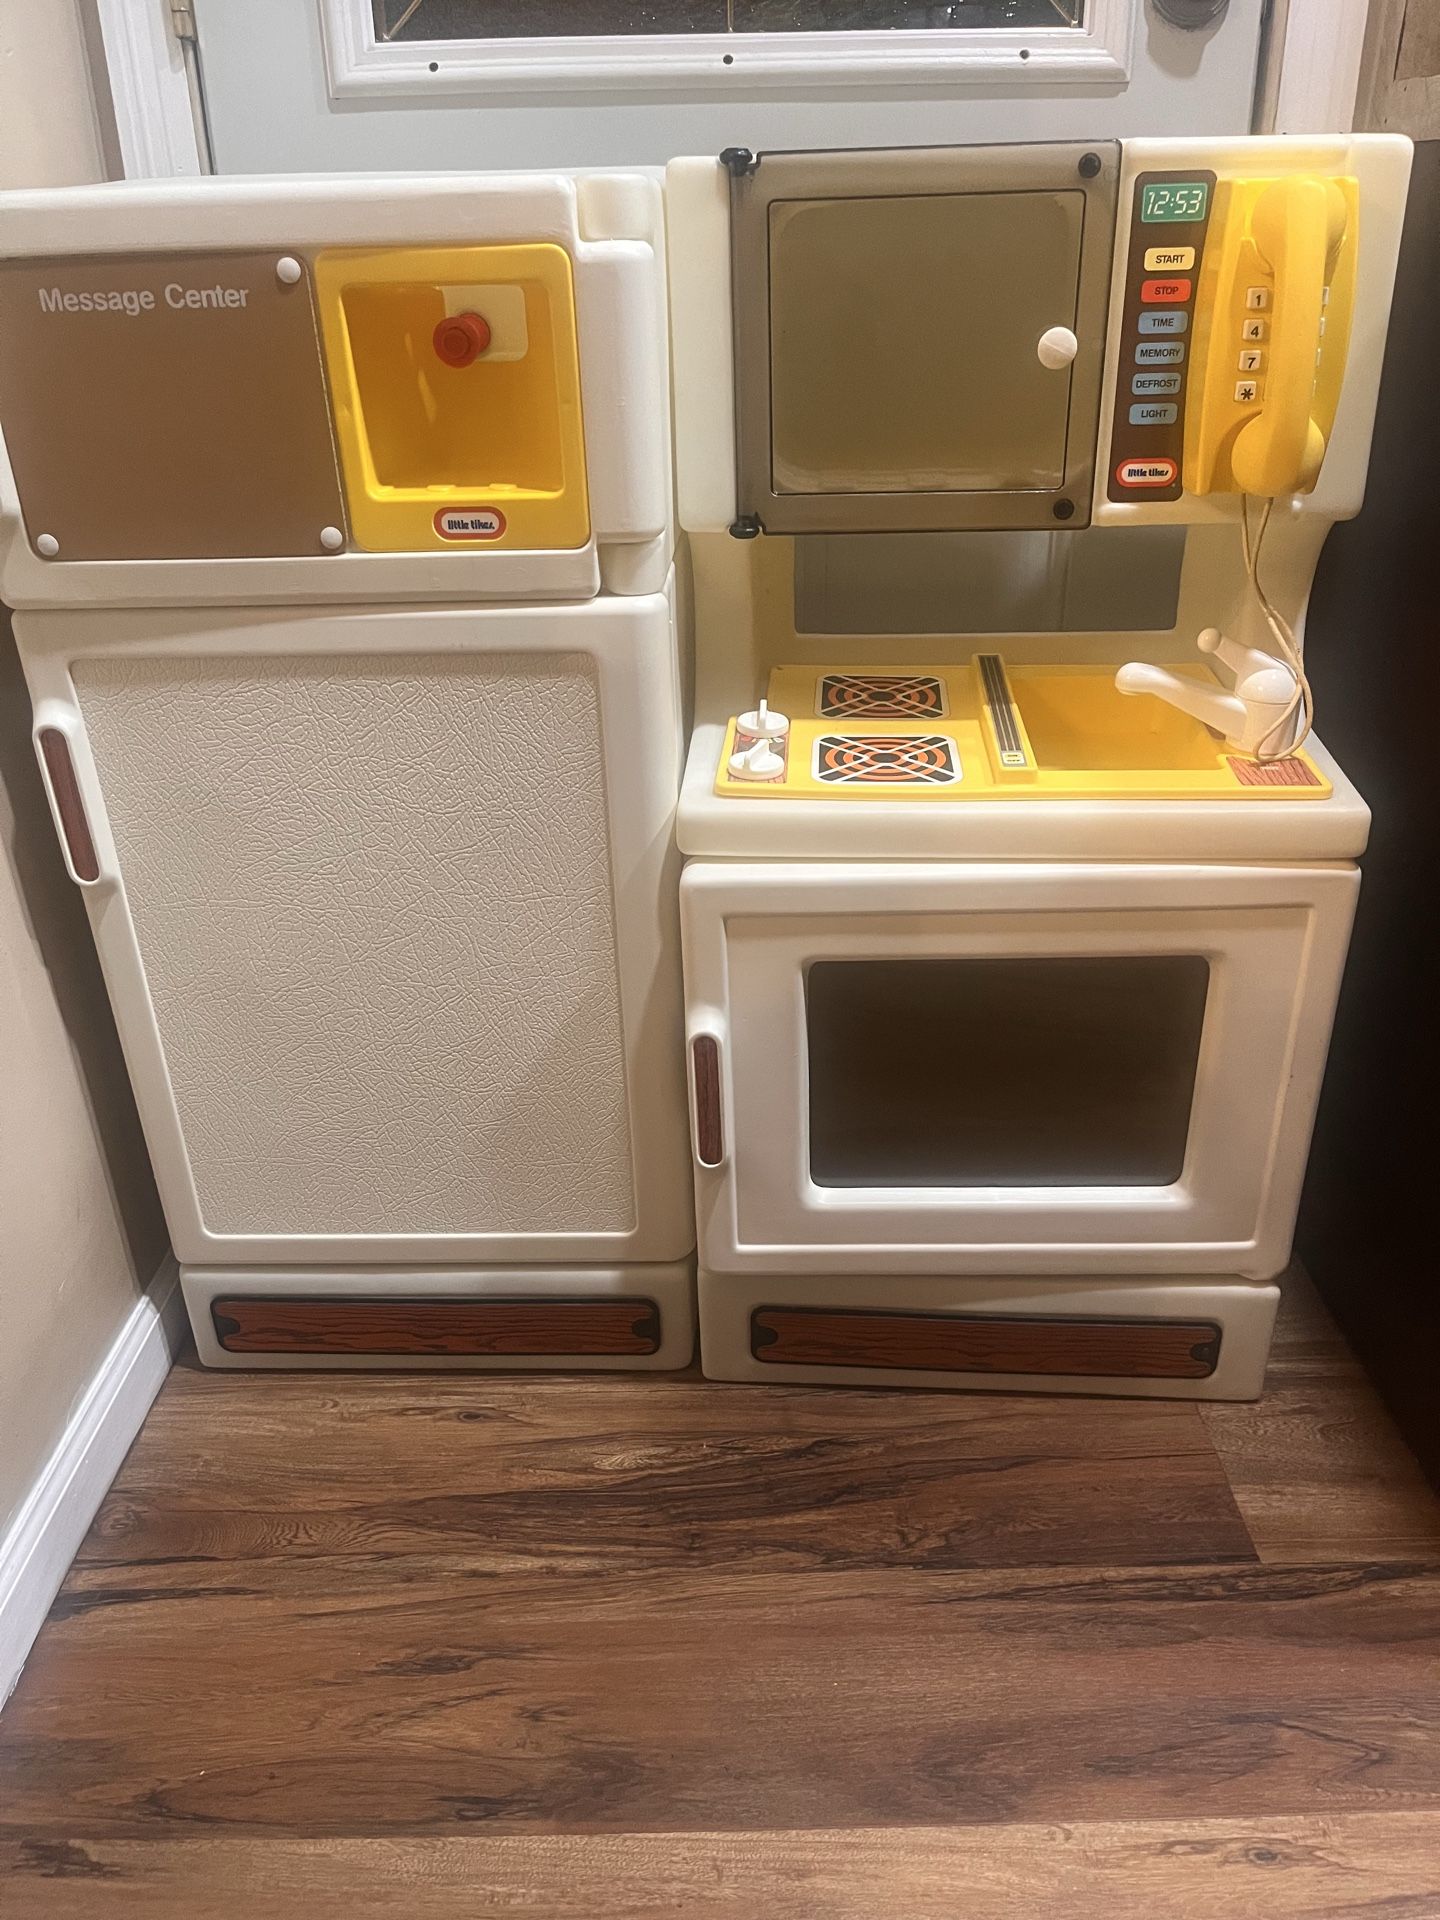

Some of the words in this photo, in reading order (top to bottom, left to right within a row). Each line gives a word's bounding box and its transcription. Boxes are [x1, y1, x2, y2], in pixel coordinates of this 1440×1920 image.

[1147, 190, 1203, 215] 12:53
[1155, 254, 1185, 264] START
[1153, 285, 1179, 295] STOP
[38, 287, 156, 316] Message
[164, 283, 249, 309] Center
[1255, 294, 1262, 306] 1
[1151, 317, 1175, 327] TIME
[1250, 326, 1260, 338] 4
[1139, 348, 1181, 358] MEMORY
[1247, 357, 1257, 369] 7
[1135, 379, 1178, 389] DEFROST
[1140, 409, 1169, 418] LIGHT
[1127, 468, 1147, 477] little
[447, 519, 470, 530] little
